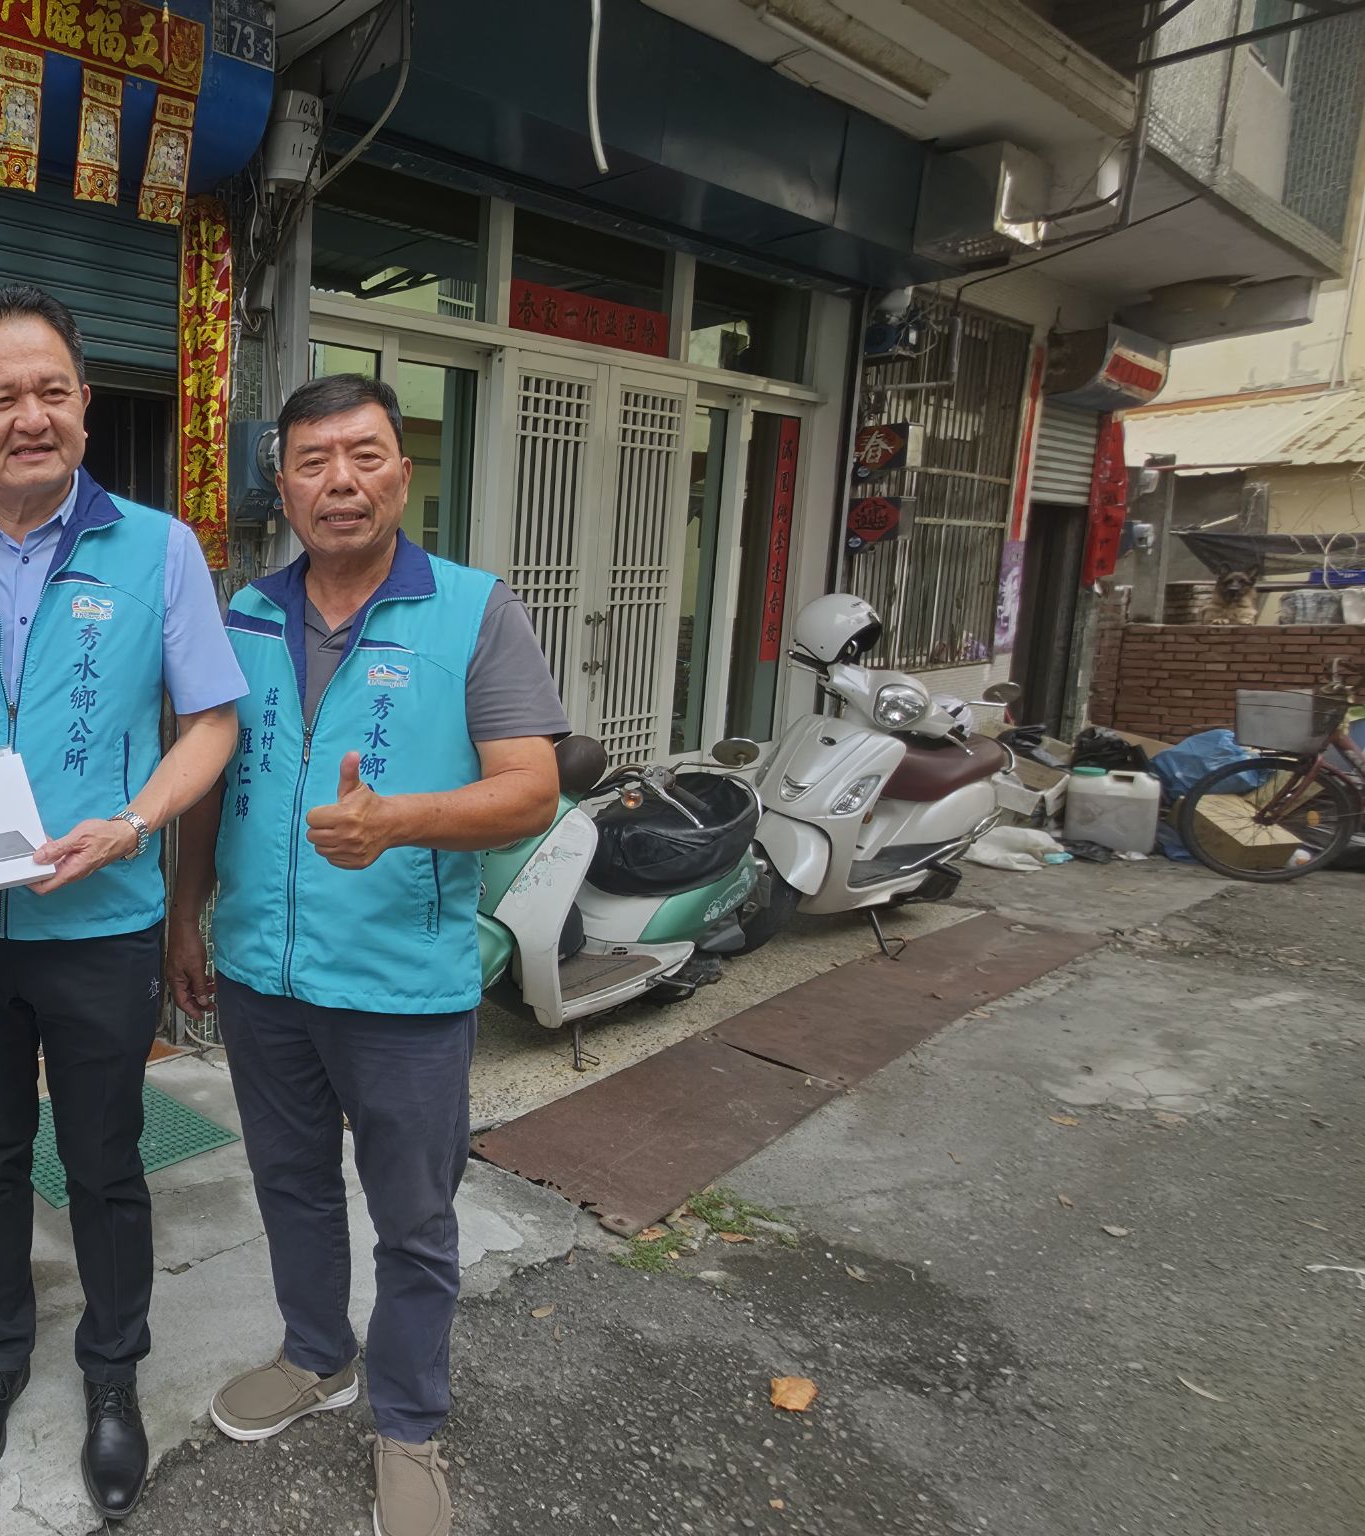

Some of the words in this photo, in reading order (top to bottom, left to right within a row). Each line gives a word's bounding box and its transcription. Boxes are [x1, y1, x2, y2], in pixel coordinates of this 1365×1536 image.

[859, 430, 895, 464] 春
[62, 623, 102, 777] 秀水鄉公所
[259, 687, 279, 774] 莊雅村長
[359, 693, 395, 791] 秀水鄉
